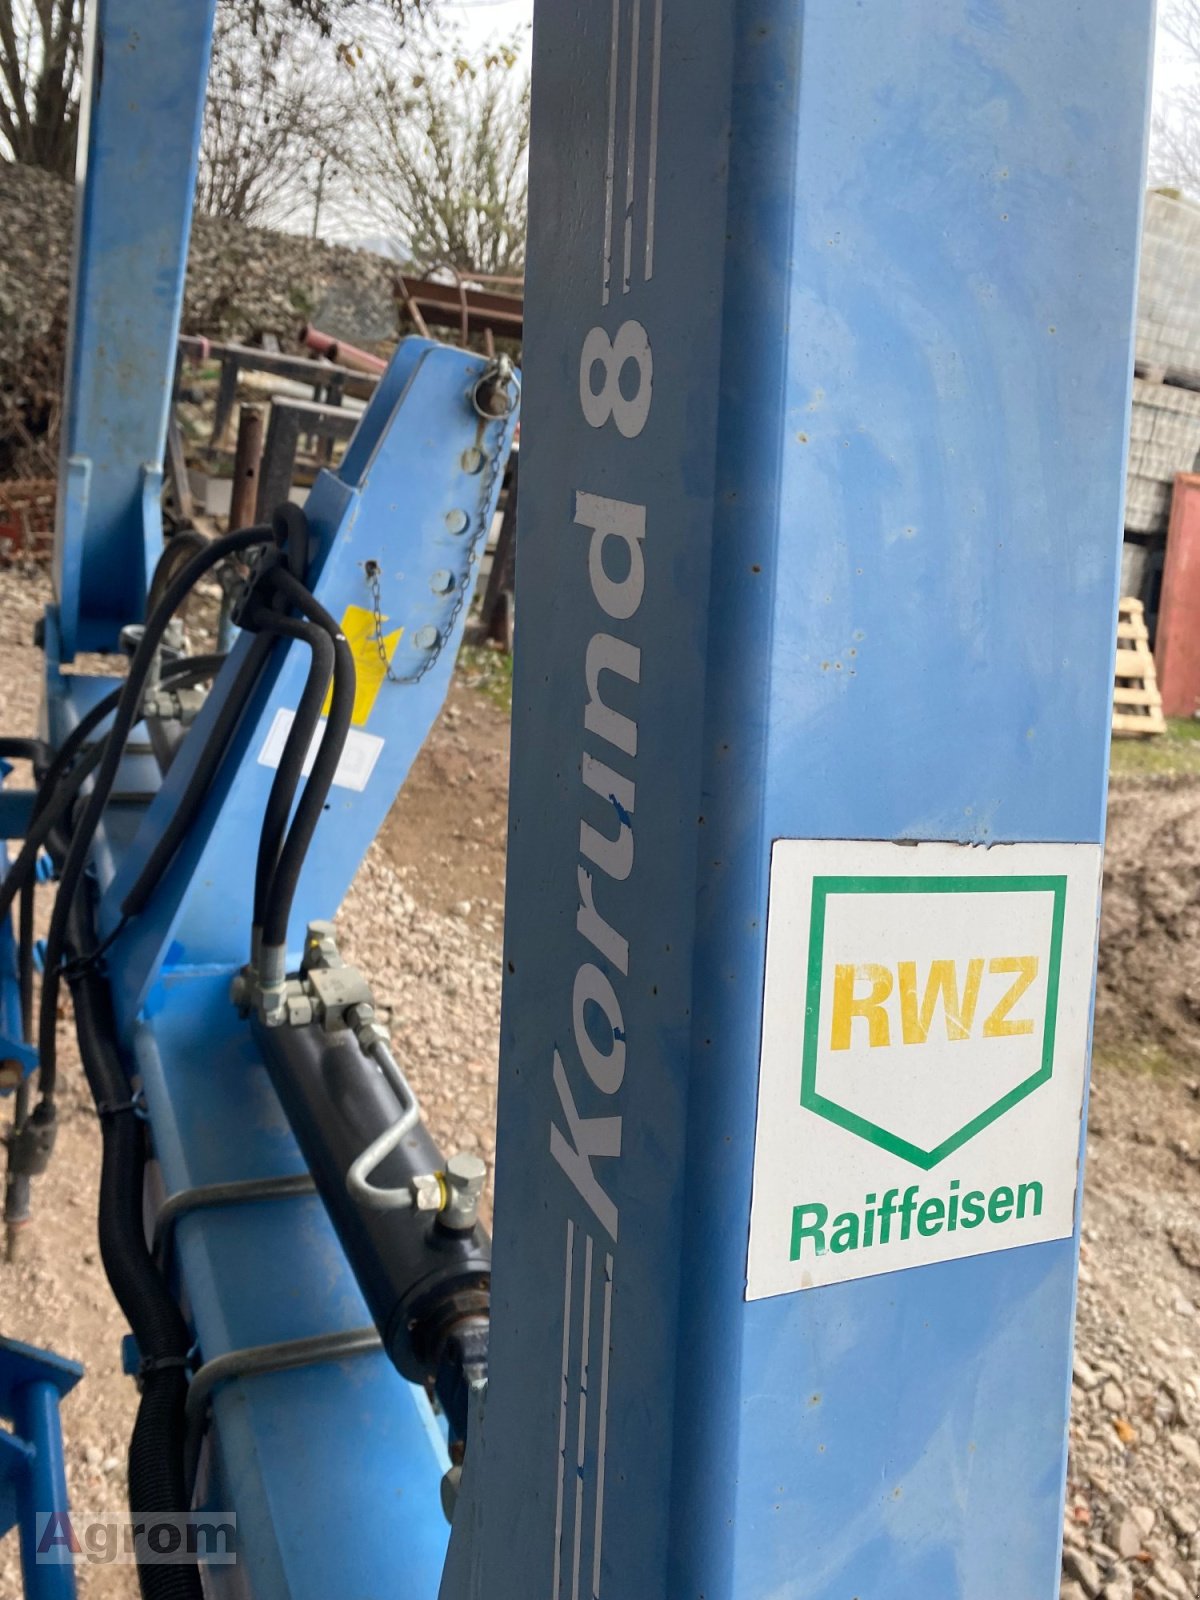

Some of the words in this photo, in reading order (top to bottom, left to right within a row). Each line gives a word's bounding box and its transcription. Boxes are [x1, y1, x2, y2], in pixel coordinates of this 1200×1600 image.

[579, 319, 653, 438] 8
[550, 490, 646, 1243] Korund
[830, 956, 1039, 1051] RWZ
[789, 1179, 1044, 1261] Raiffeisen
